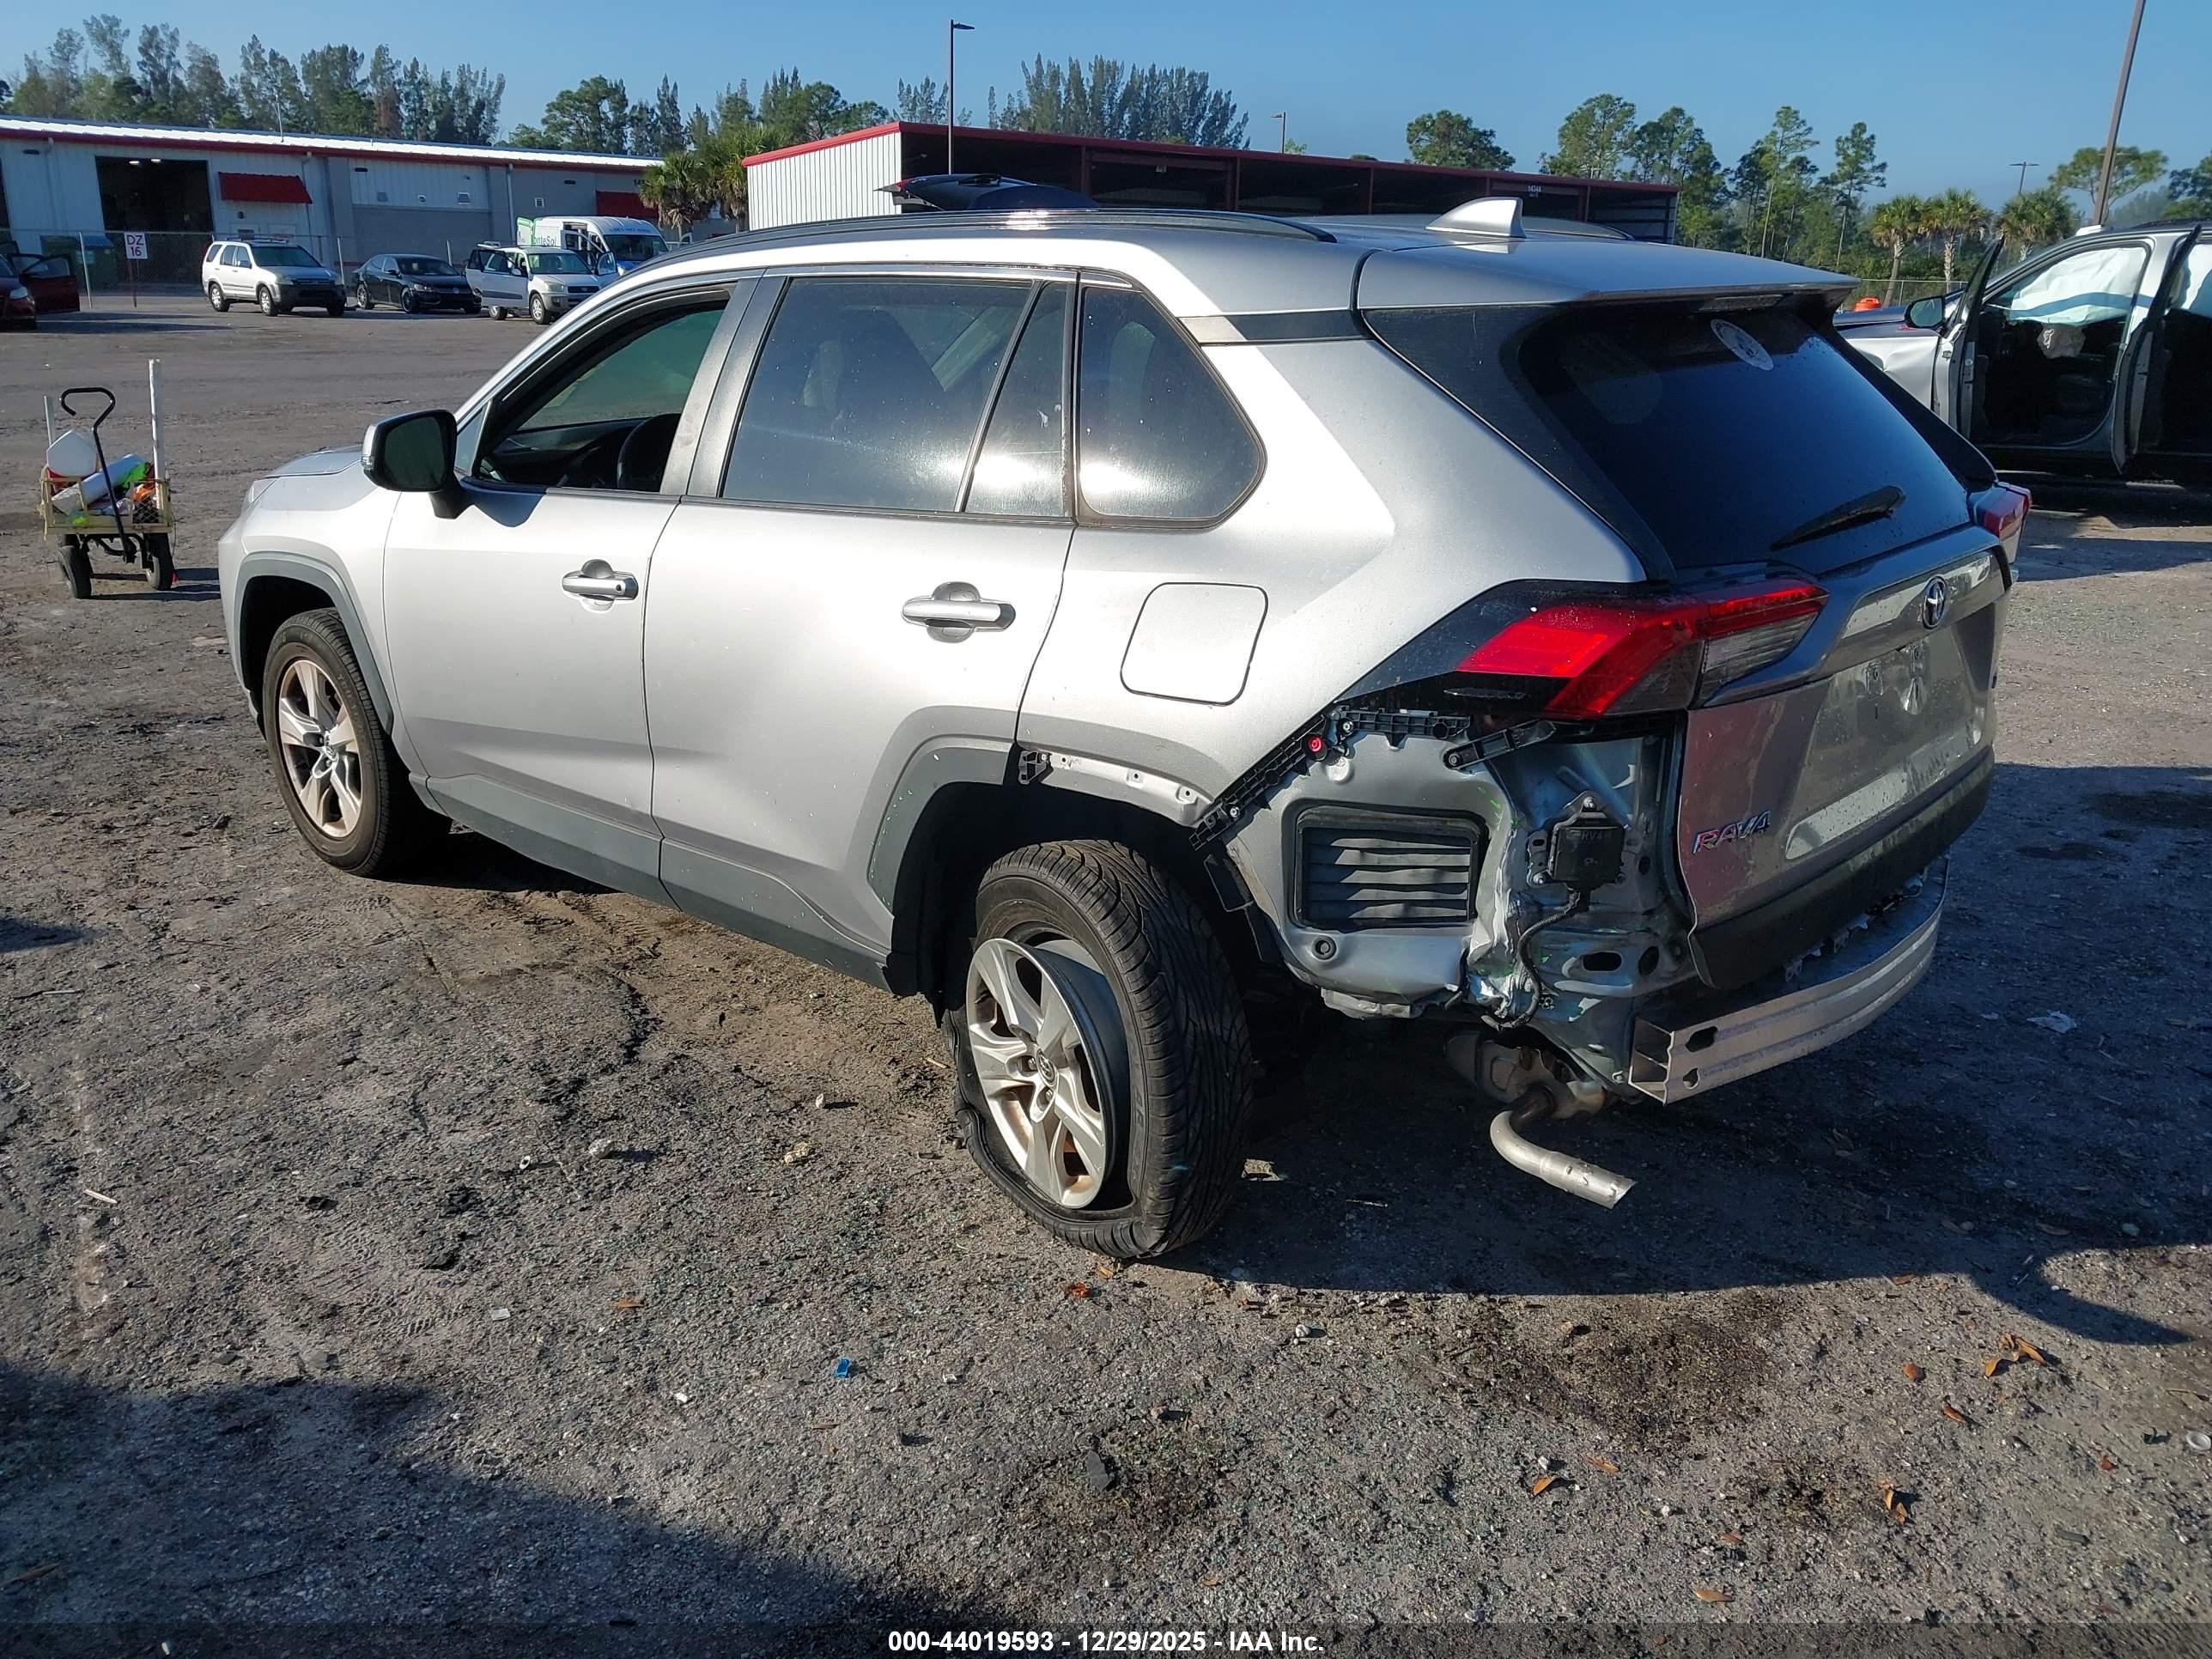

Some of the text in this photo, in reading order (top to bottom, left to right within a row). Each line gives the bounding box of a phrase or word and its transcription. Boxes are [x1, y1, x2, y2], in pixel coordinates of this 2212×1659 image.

[126, 234, 144, 246] DZ
[131, 246, 142, 257] 16
[1691, 810, 1771, 854] RAV4
